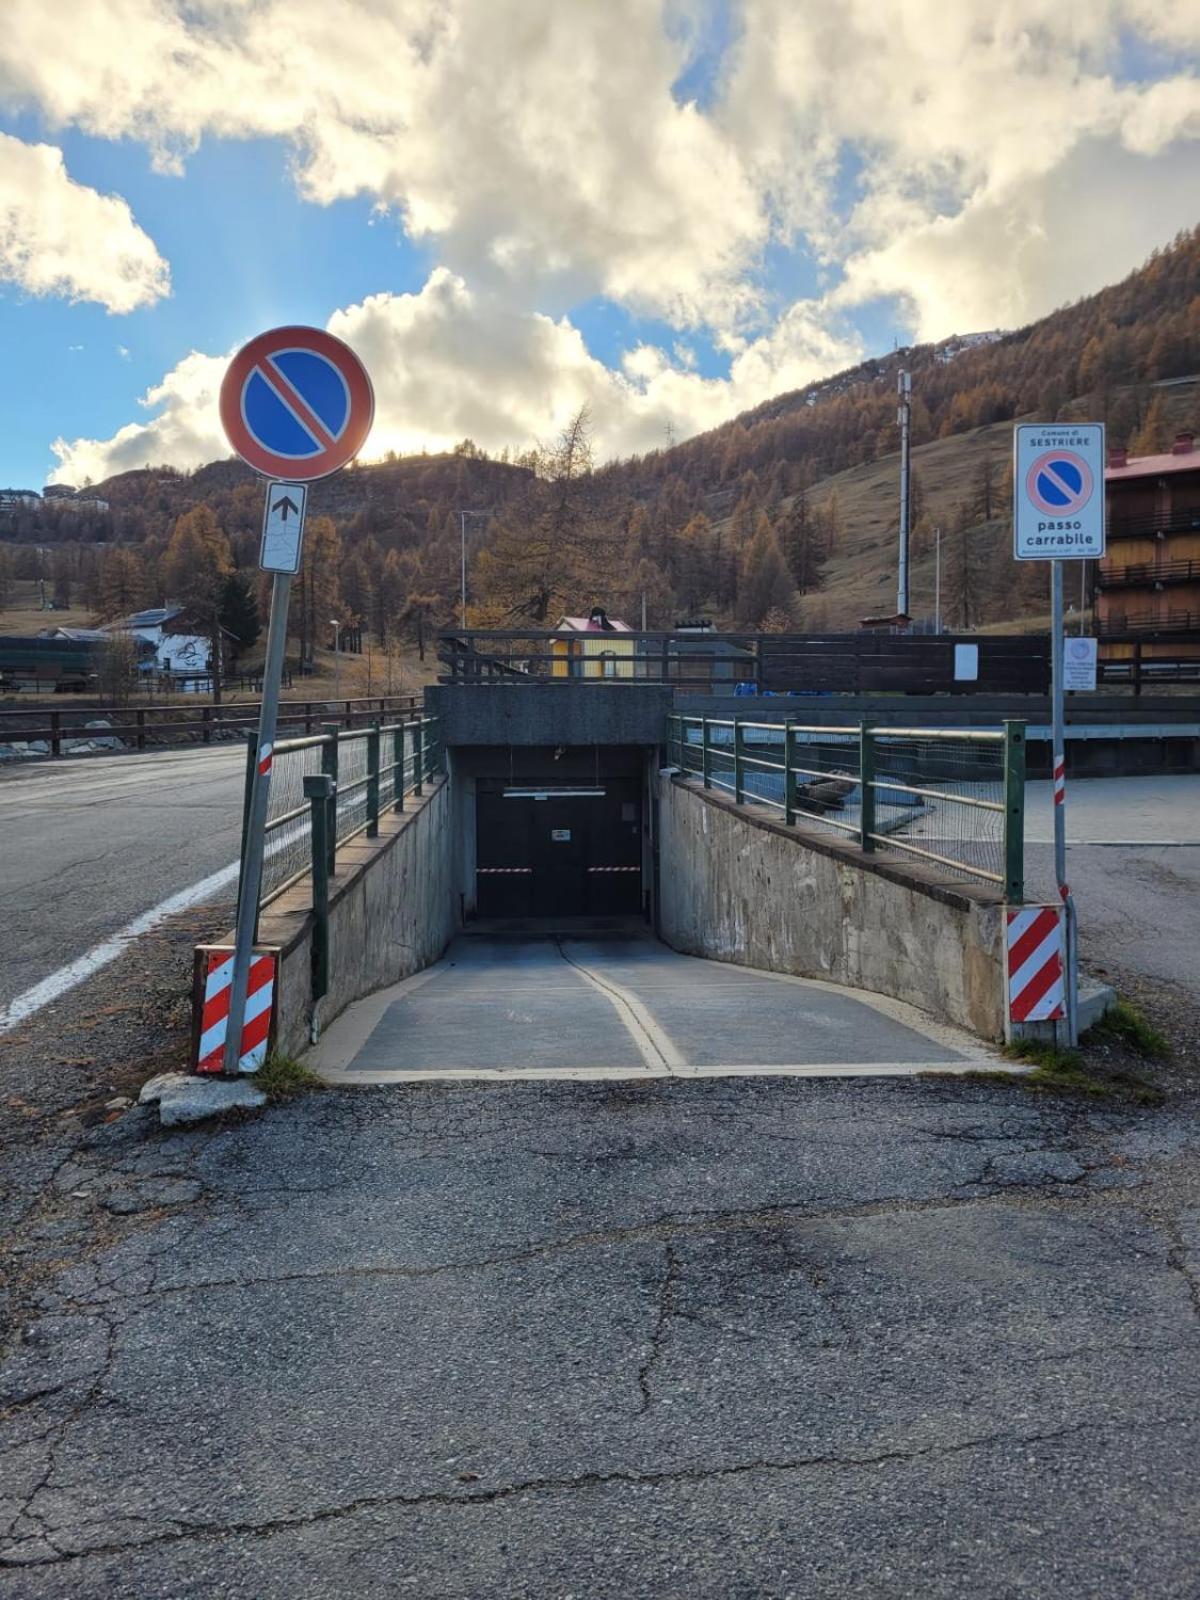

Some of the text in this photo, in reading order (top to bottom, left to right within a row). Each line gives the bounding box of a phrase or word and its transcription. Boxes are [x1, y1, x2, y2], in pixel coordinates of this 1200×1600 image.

[1030, 438, 1090, 447] SESTRIERE
[1038, 521, 1082, 532] passo
[1026, 534, 1093, 545] carrabile
